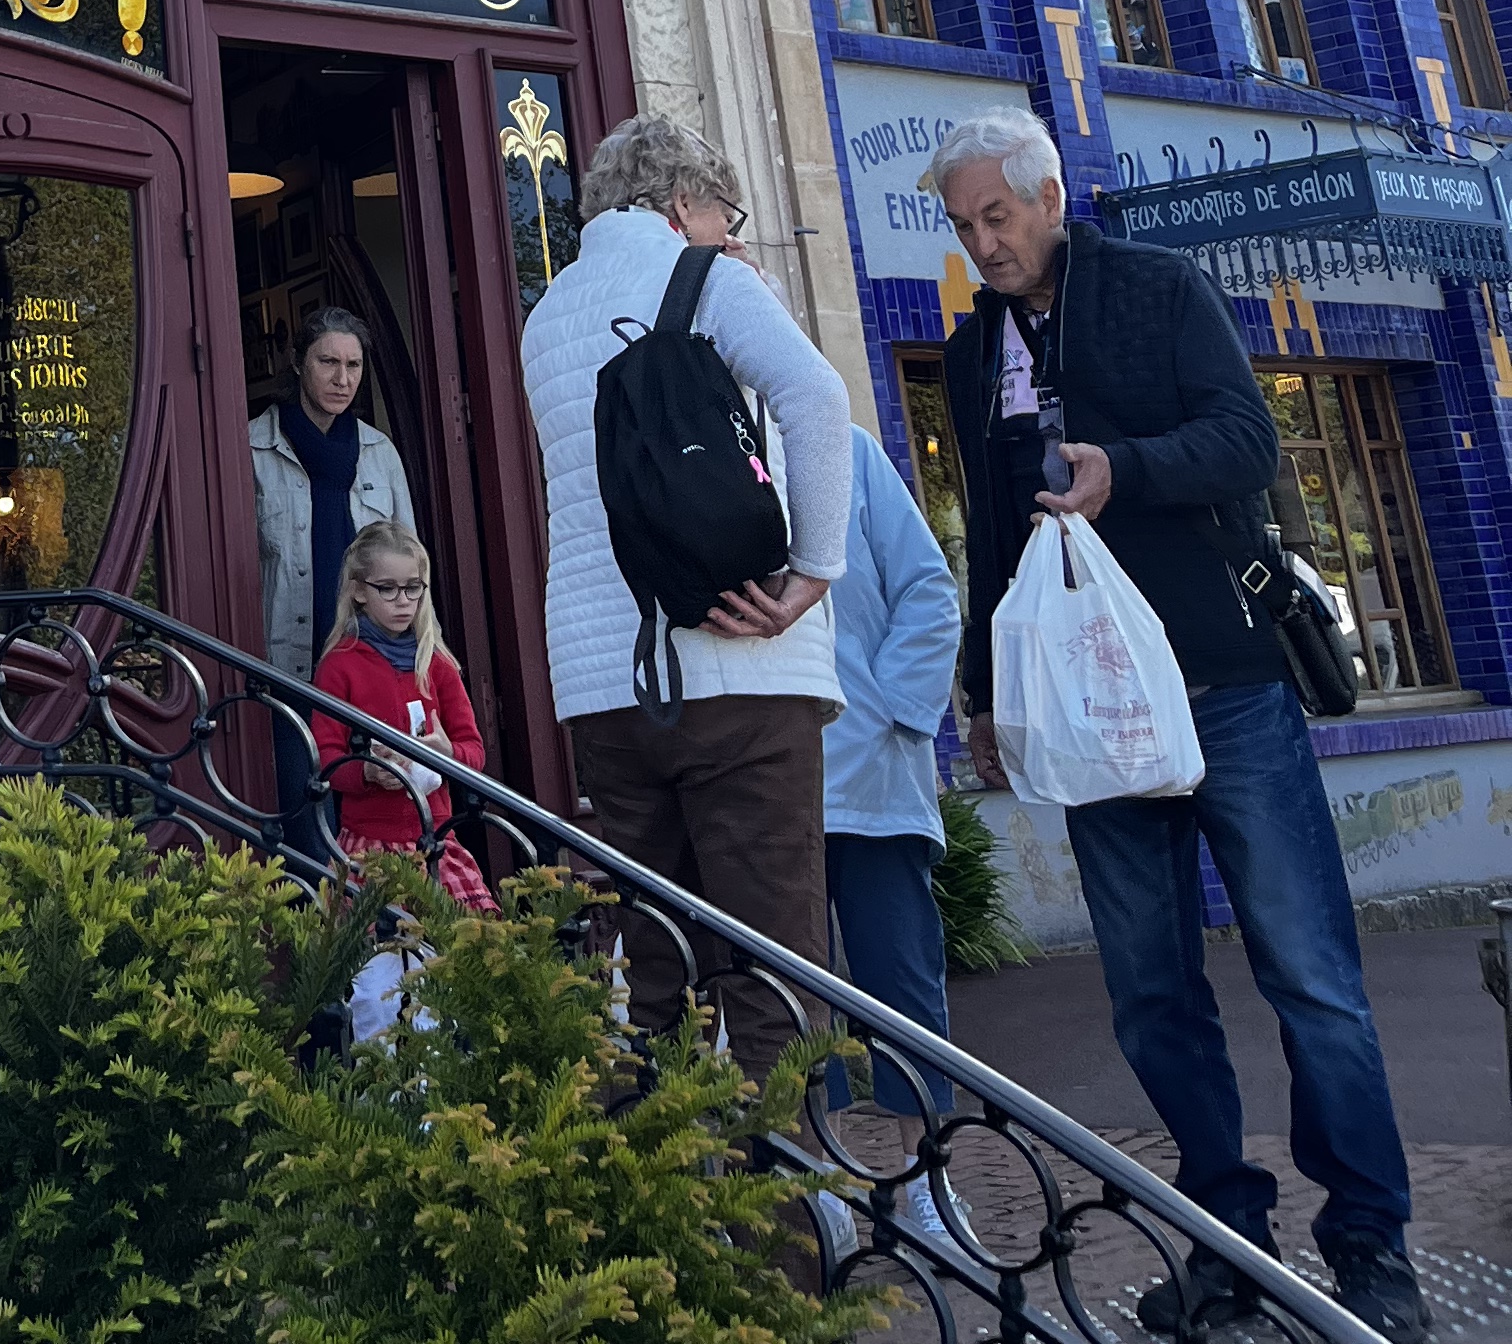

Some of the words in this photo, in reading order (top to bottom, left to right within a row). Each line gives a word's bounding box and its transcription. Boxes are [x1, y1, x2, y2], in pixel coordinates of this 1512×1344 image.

[850, 122, 903, 174] POUR
[899, 116, 931, 154] LES
[884, 192, 953, 234] ENFA
[1121, 202, 1165, 241] JEUX
[1169, 188, 1247, 227] SPORTIFS
[1253, 183, 1282, 212] DE
[1288, 169, 1356, 207] SALON
[1375, 169, 1410, 201] JEUX
[1409, 174, 1430, 201] DE
[1430, 176, 1484, 212] HASARD
